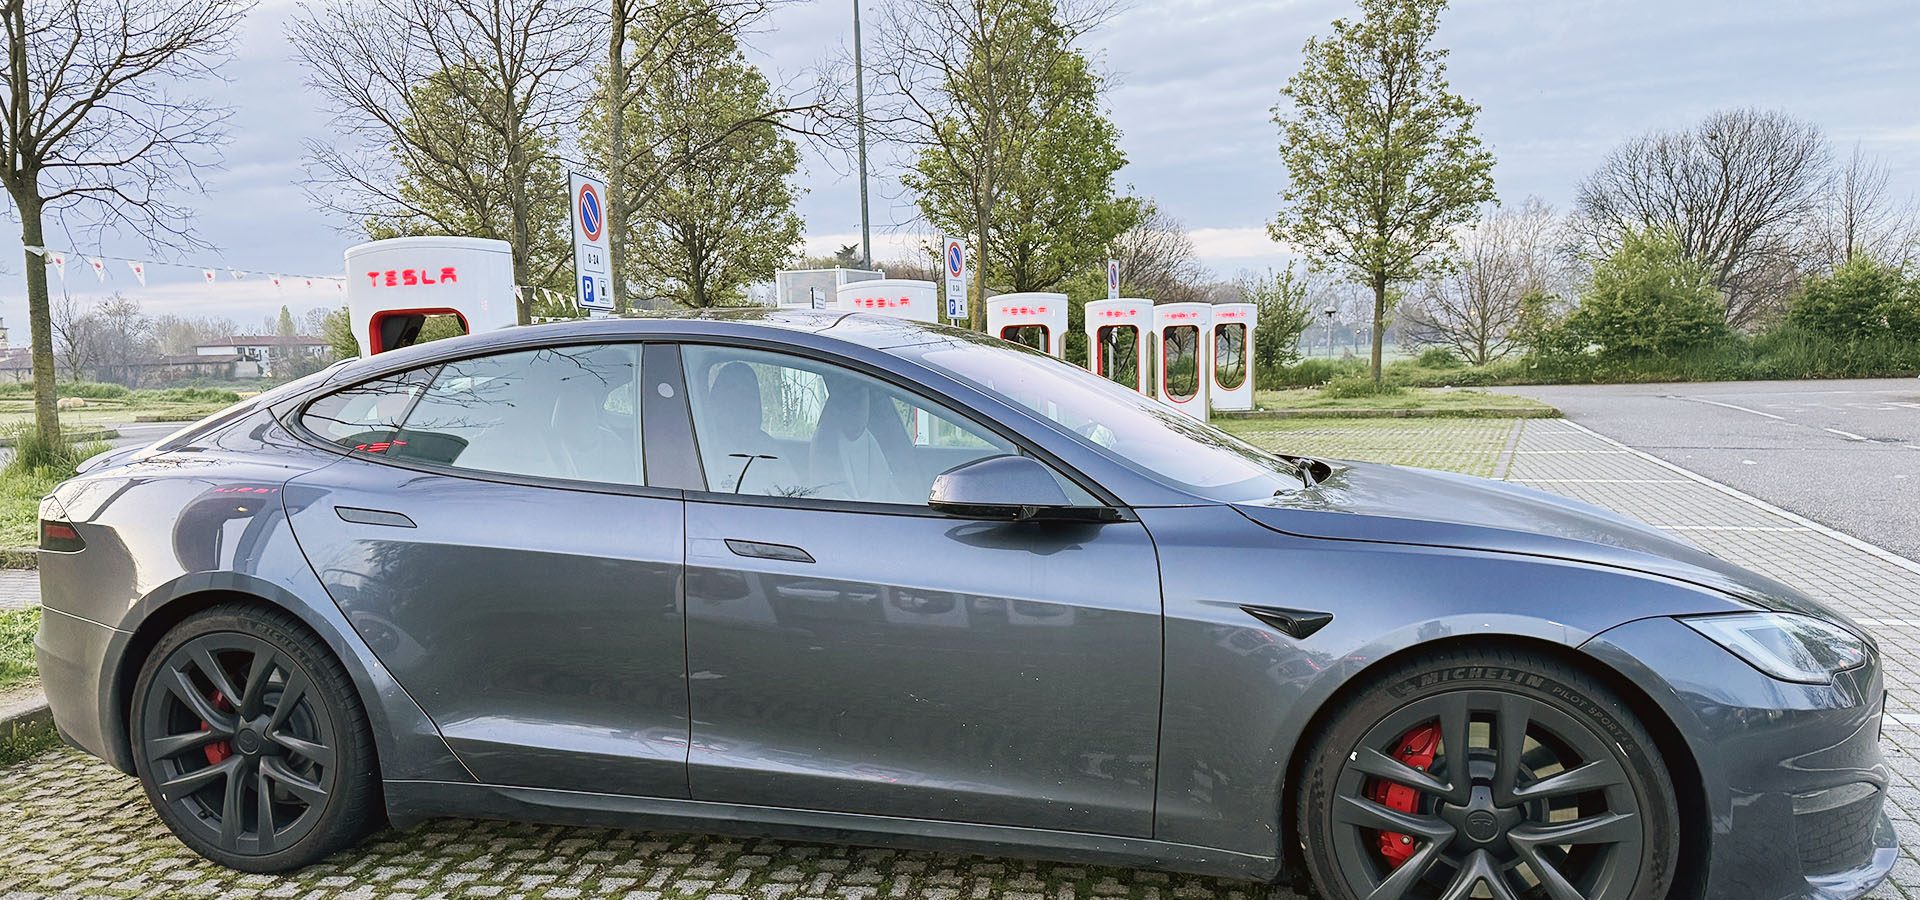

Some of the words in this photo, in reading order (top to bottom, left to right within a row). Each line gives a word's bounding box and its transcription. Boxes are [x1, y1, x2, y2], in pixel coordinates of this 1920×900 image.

[367, 267, 457, 287] TESLA
[585, 280, 592, 299] P
[854, 296, 910, 308] TESLA
[1421, 667, 1545, 689] MICHELIN
[1552, 686, 1587, 707] PILOT
[1588, 707, 1623, 736] SPORT
